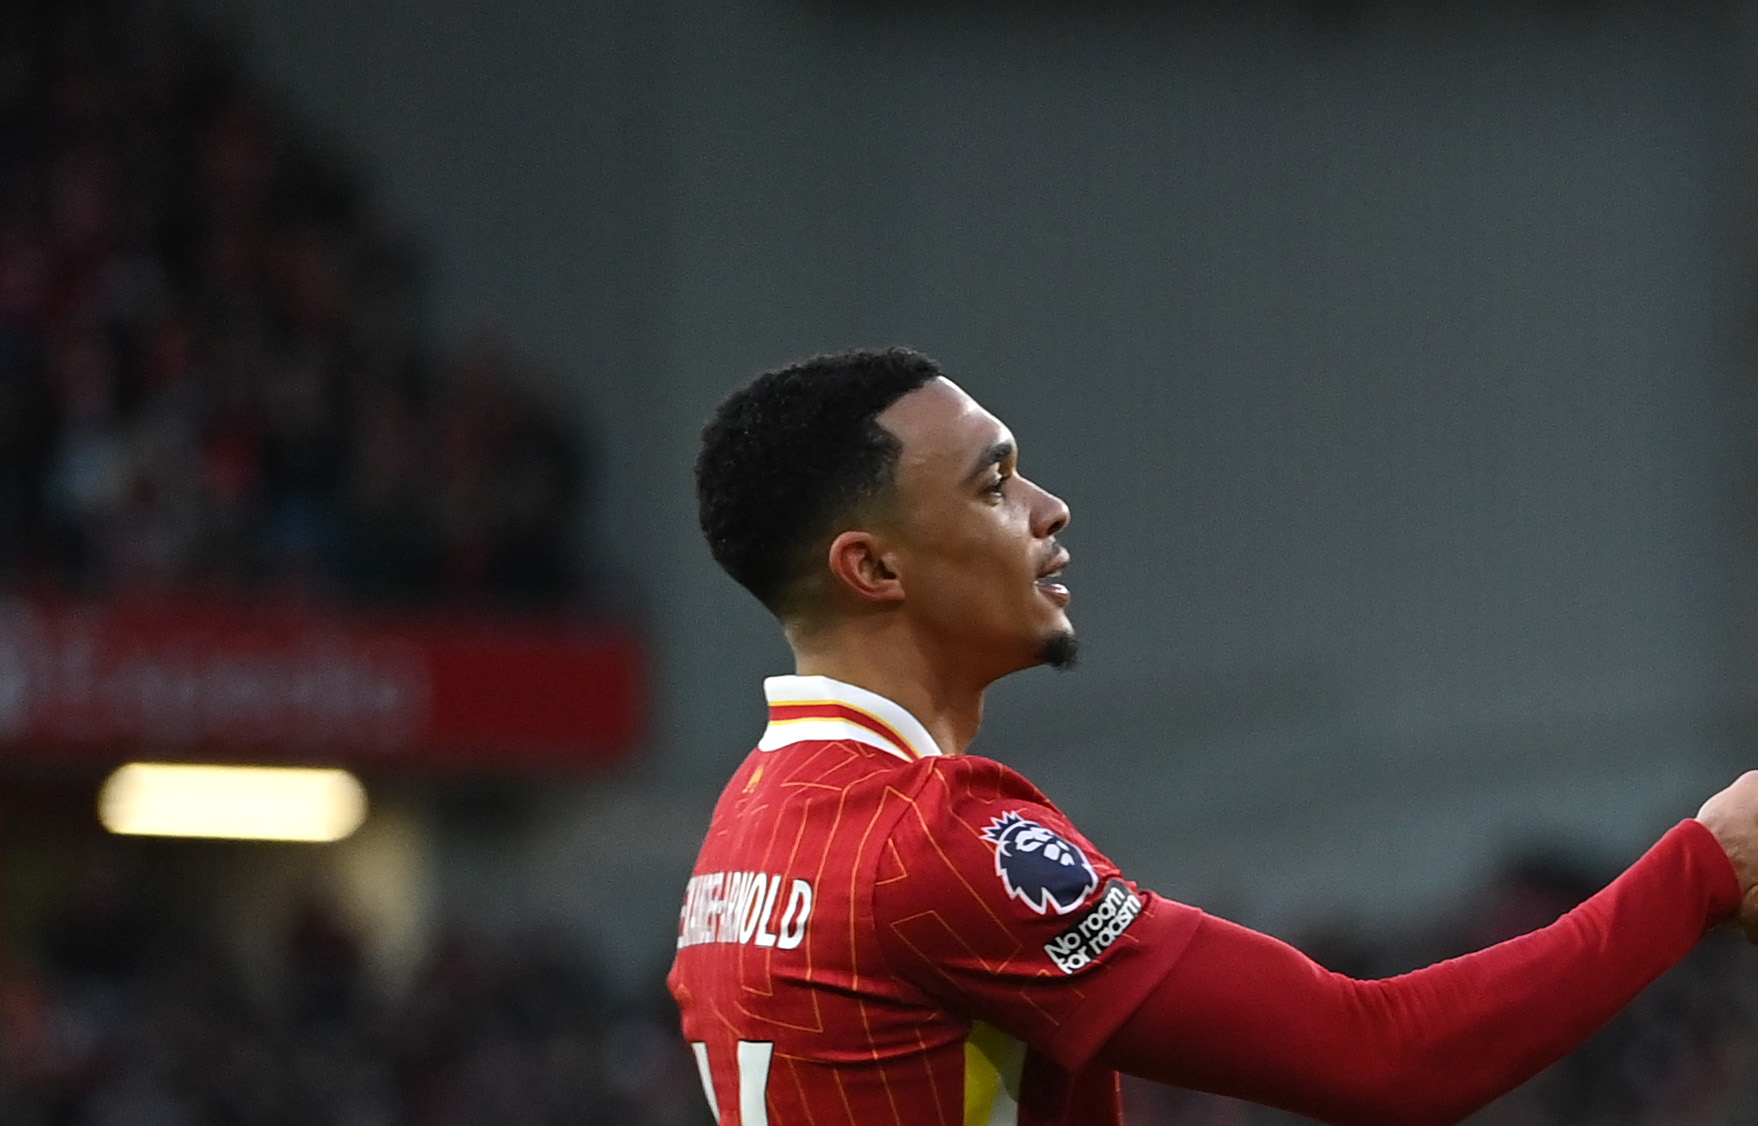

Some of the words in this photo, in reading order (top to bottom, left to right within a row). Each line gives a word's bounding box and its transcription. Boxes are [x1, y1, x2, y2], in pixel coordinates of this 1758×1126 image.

[1044, 932, 1081, 964] No
[1078, 887, 1126, 938] room
[1057, 945, 1091, 975] for
